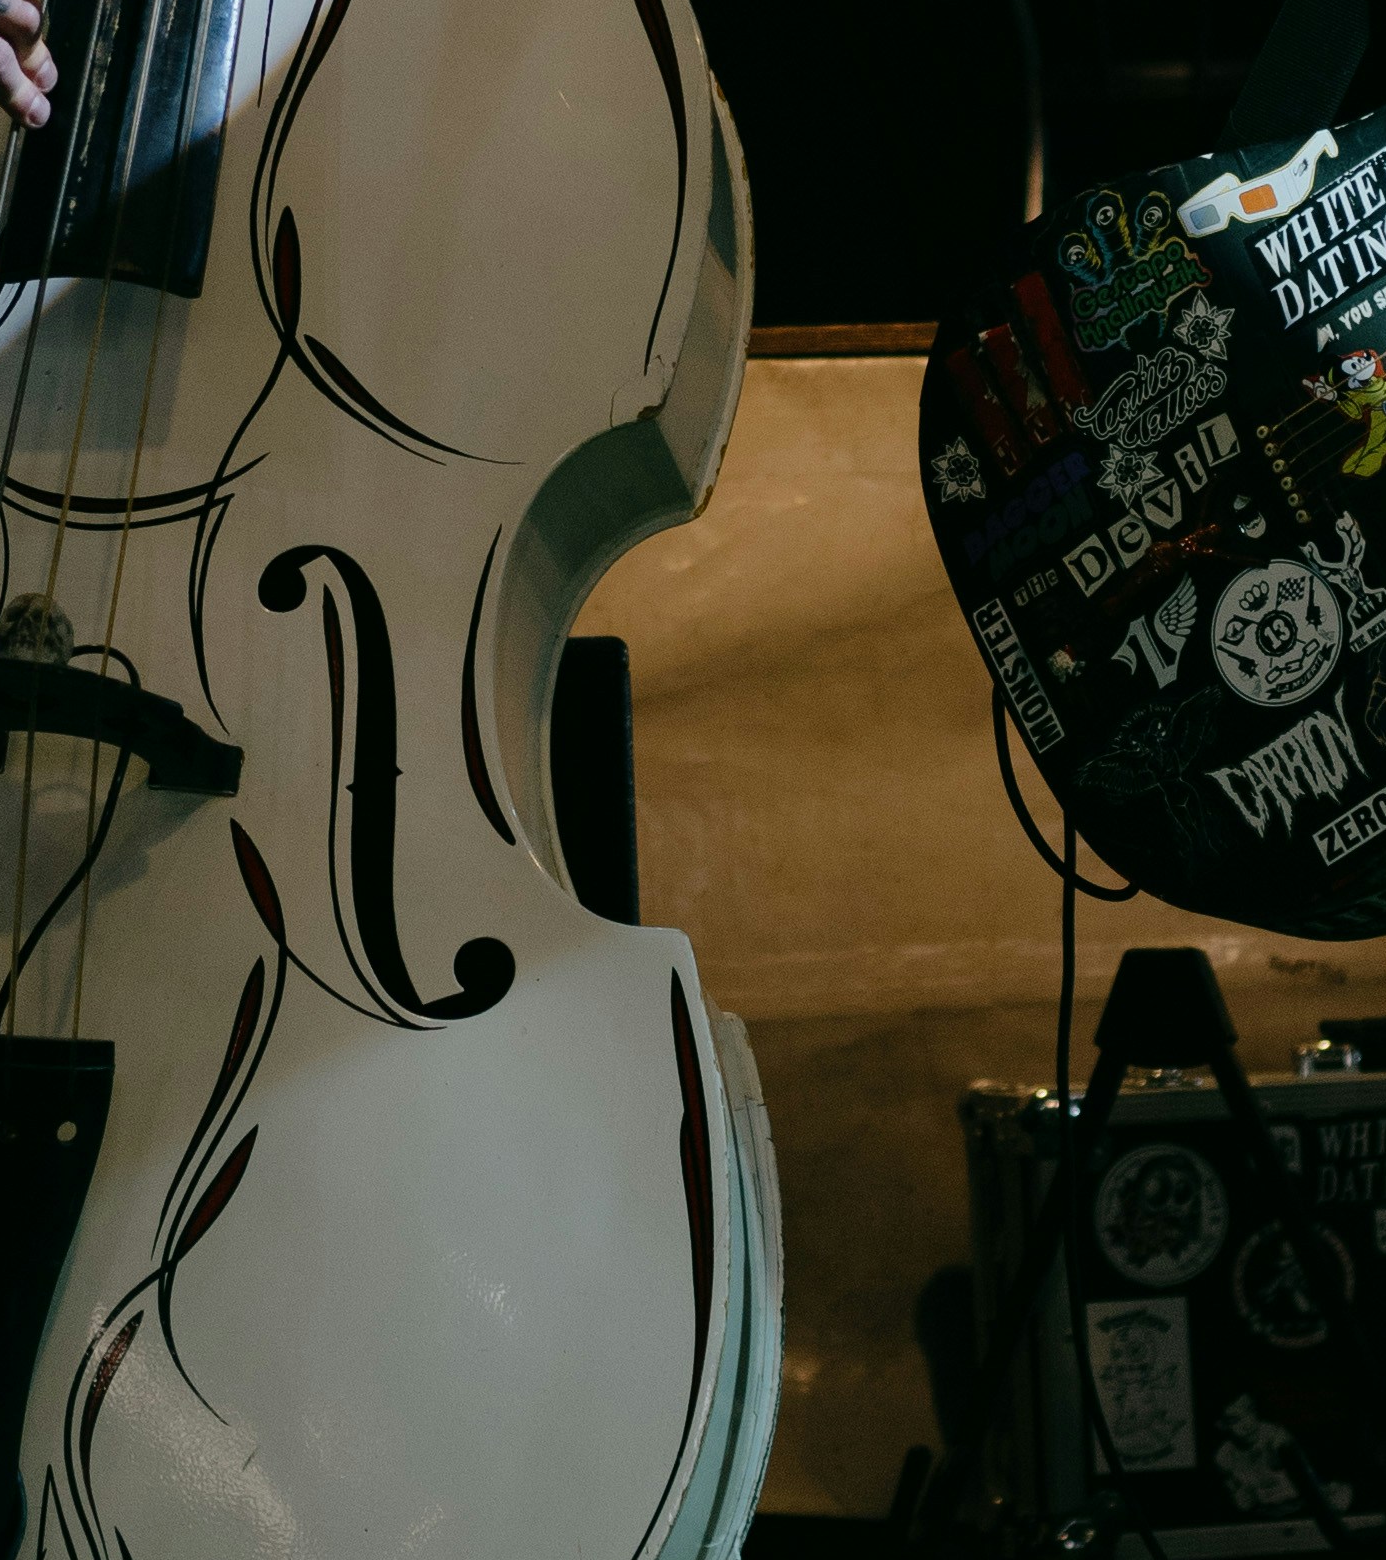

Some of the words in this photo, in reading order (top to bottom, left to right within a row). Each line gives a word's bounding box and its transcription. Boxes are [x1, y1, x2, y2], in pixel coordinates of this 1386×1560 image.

[1255, 166, 1386, 279] WHITE
[1074, 241, 1183, 316] Gestapo
[1337, 298, 1374, 331] YOU
[1262, 617, 1289, 651] 13
[1350, 634, 1369, 653] THE
[978, 602, 1064, 750] MONSTER
[1204, 683, 1370, 837] CARRION
